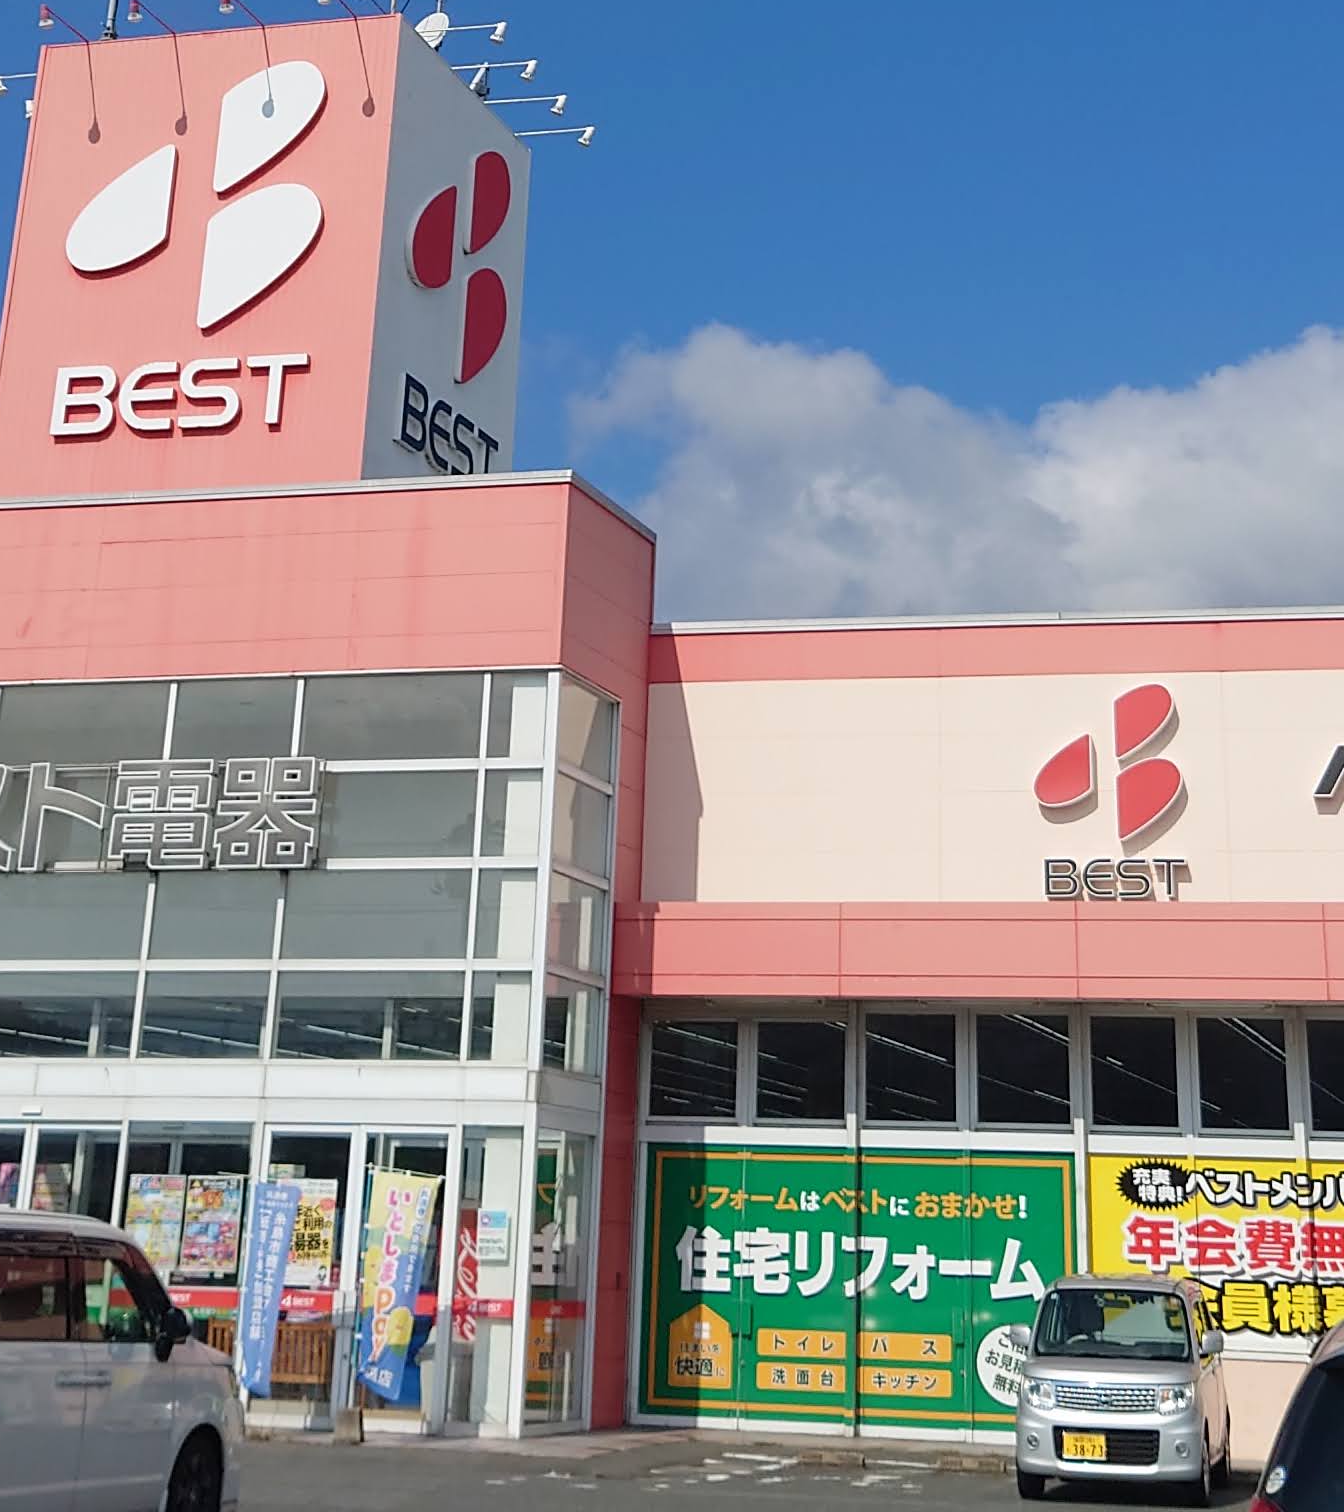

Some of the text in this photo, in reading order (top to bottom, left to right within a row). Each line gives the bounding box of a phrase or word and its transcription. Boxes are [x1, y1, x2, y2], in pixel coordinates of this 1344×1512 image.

[50, 353, 310, 437] BEST
[398, 372, 500, 475] BEST
[1043, 858, 1188, 898] BEST
[676, 1226, 1044, 1303] 住宅リフォーム
[293, 1296, 315, 1305] BEST
[772, 1335, 835, 1354] トイレ
[771, 1368, 835, 1387] 洗面台
[871, 1372, 938, 1390] キッチン
